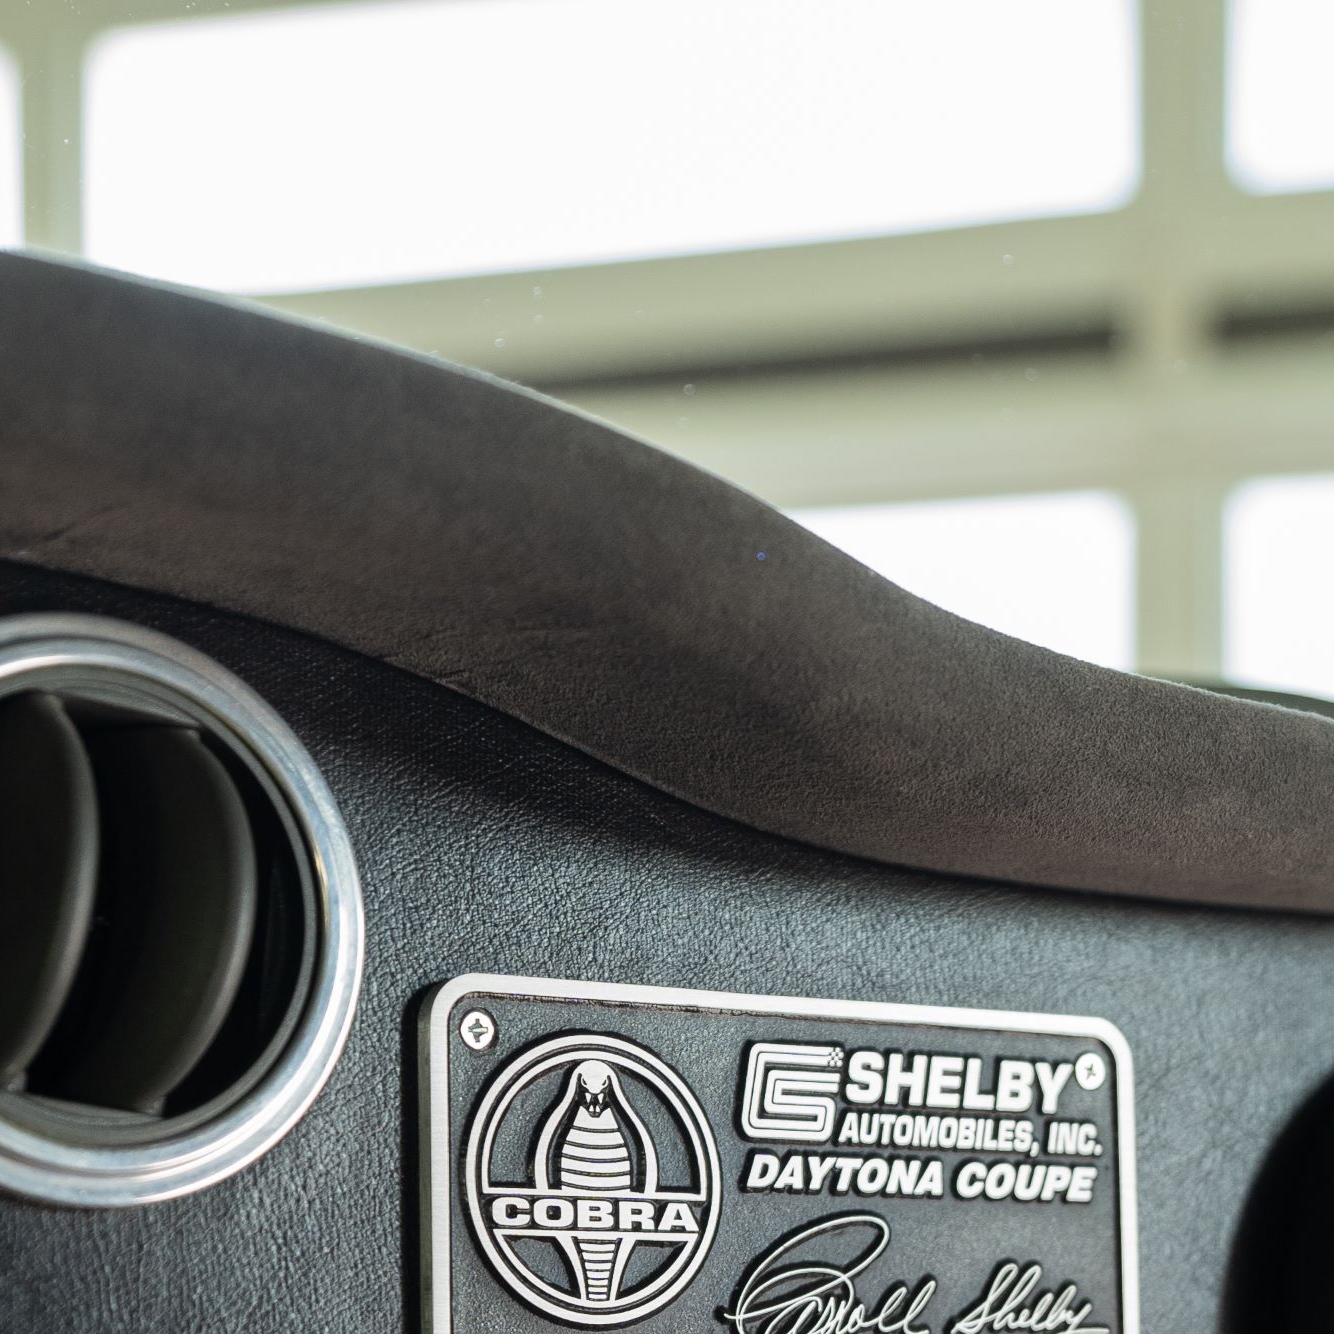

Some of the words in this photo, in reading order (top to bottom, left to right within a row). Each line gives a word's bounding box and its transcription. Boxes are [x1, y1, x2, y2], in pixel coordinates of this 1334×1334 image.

[846, 1051, 1074, 1114] SHELBY
[838, 1113, 1039, 1157] AUTOMOBILES,
[1047, 1121, 1103, 1156] INC.
[747, 1153, 944, 1196] DAYTONA
[956, 1162, 1098, 1203] COUPE
[491, 1196, 700, 1233] COBRA
